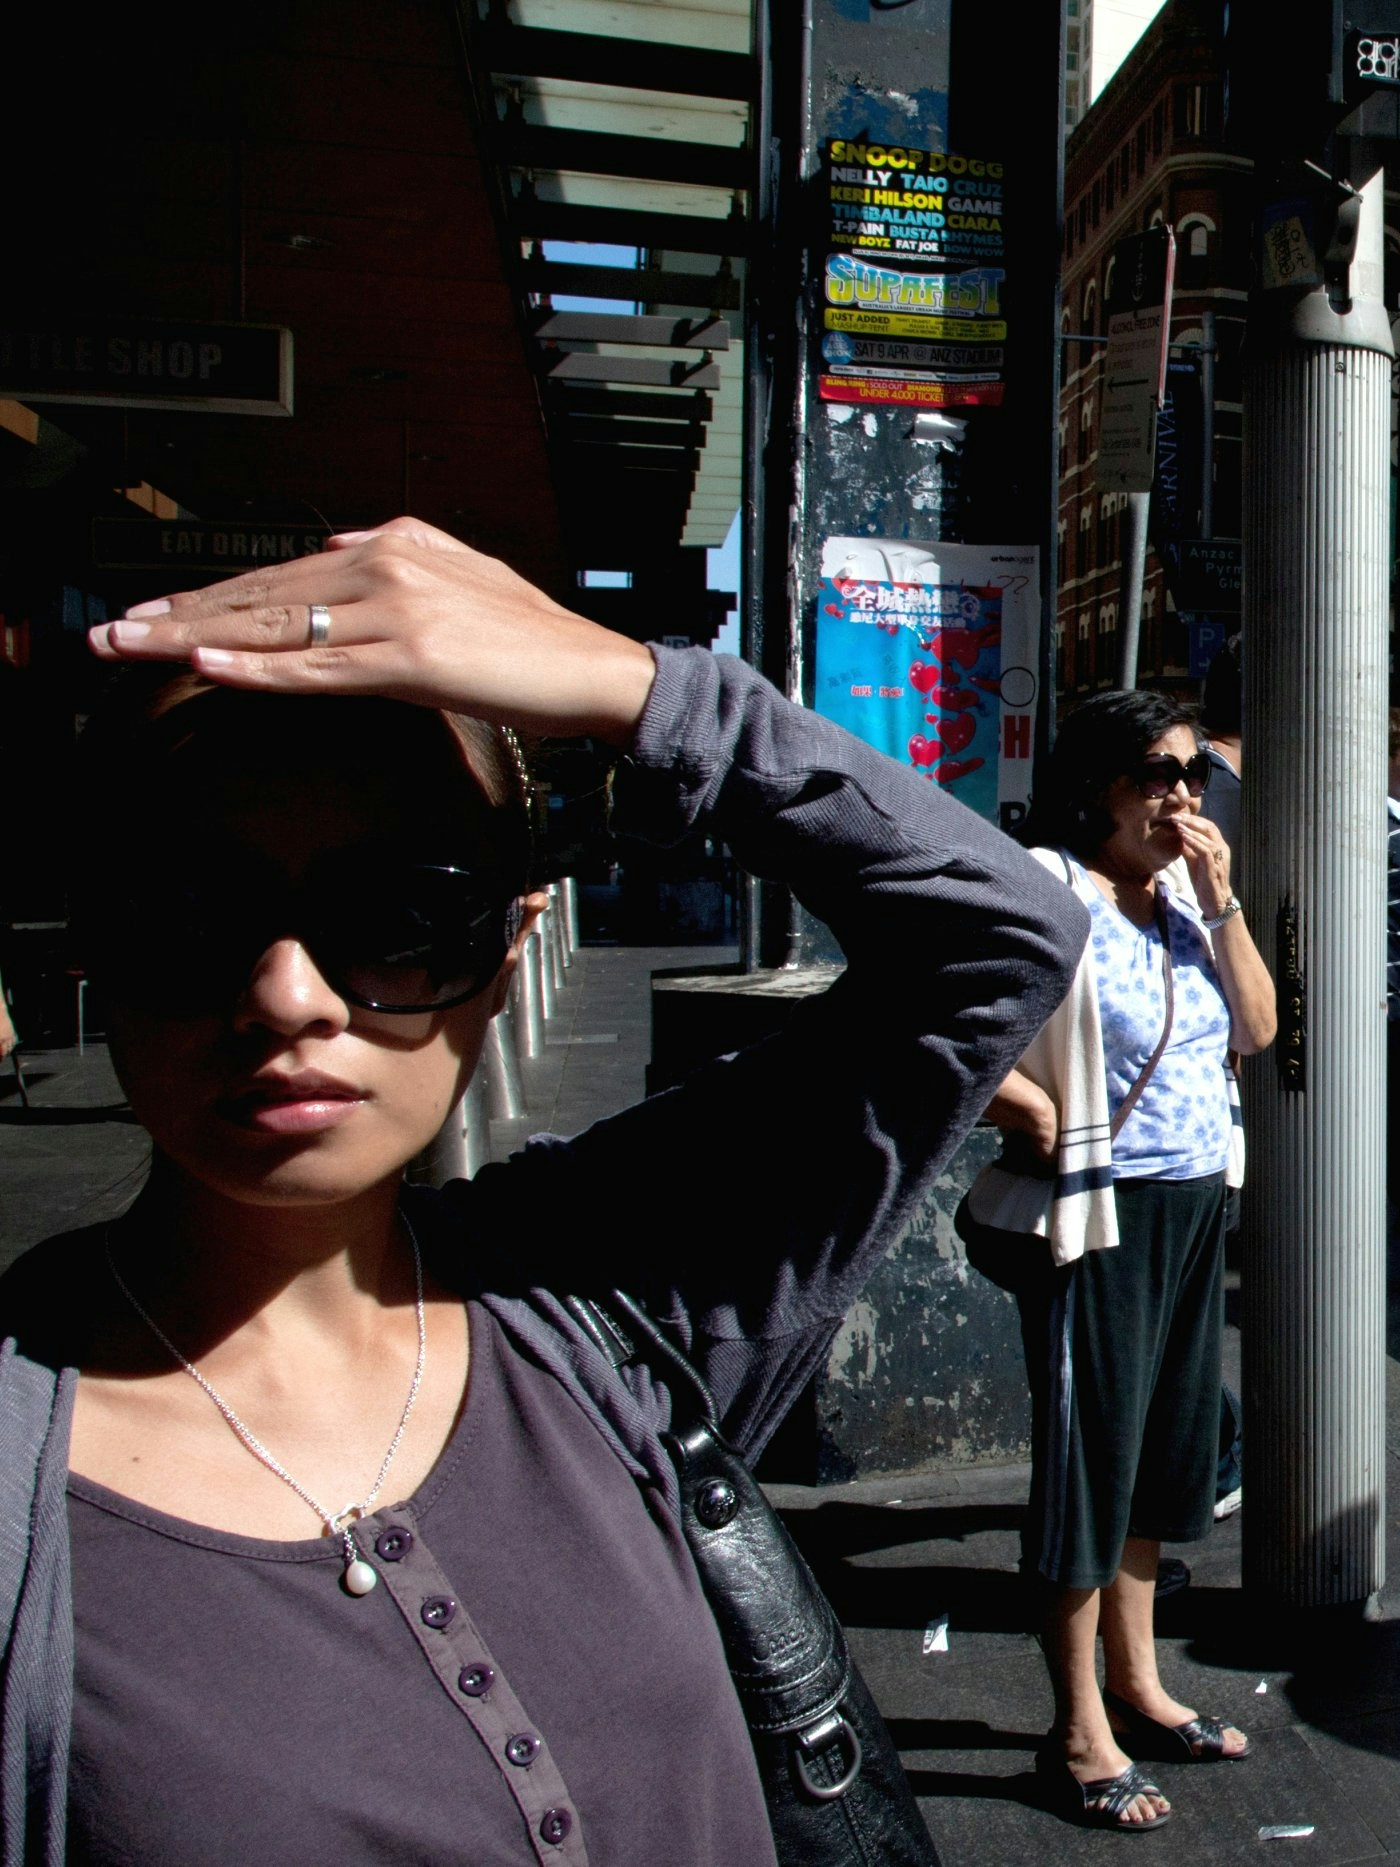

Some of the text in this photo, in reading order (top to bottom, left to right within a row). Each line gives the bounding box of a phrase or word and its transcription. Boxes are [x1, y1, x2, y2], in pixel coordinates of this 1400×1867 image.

[830, 140, 1005, 179] SNOOP DOGG
[831, 166, 1004, 199] NELLY TAIO CRUZ
[830, 185, 1003, 216] KERI HILSON GAME
[831, 203, 1003, 233] TIMBALAND CIARA
[832, 220, 1004, 246] T-PAIN BUSTA RHYMES
[858, 236, 892, 248] BOYZ
[895, 239, 917, 250] FAT
[918, 240, 940, 253] JOE
[826, 253, 1006, 316] SUPAFEST
[830, 312, 890, 324] JUST ADDED
[107, 336, 223, 379] SHOP
[856, 343, 875, 358] SAT
[878, 345, 885, 358] 9
[889, 346, 909, 360] APR
[930, 348, 950, 363] ANZ
[859, 389, 889, 398] UNDER
[161, 529, 208, 553] EAT
[212, 533, 296, 557] DRINK
[1189, 547, 1234, 560] Anzac
[1205, 562, 1241, 576] Pyrm
[1219, 578, 1241, 590] Gle
[1199, 627, 1216, 649] P
